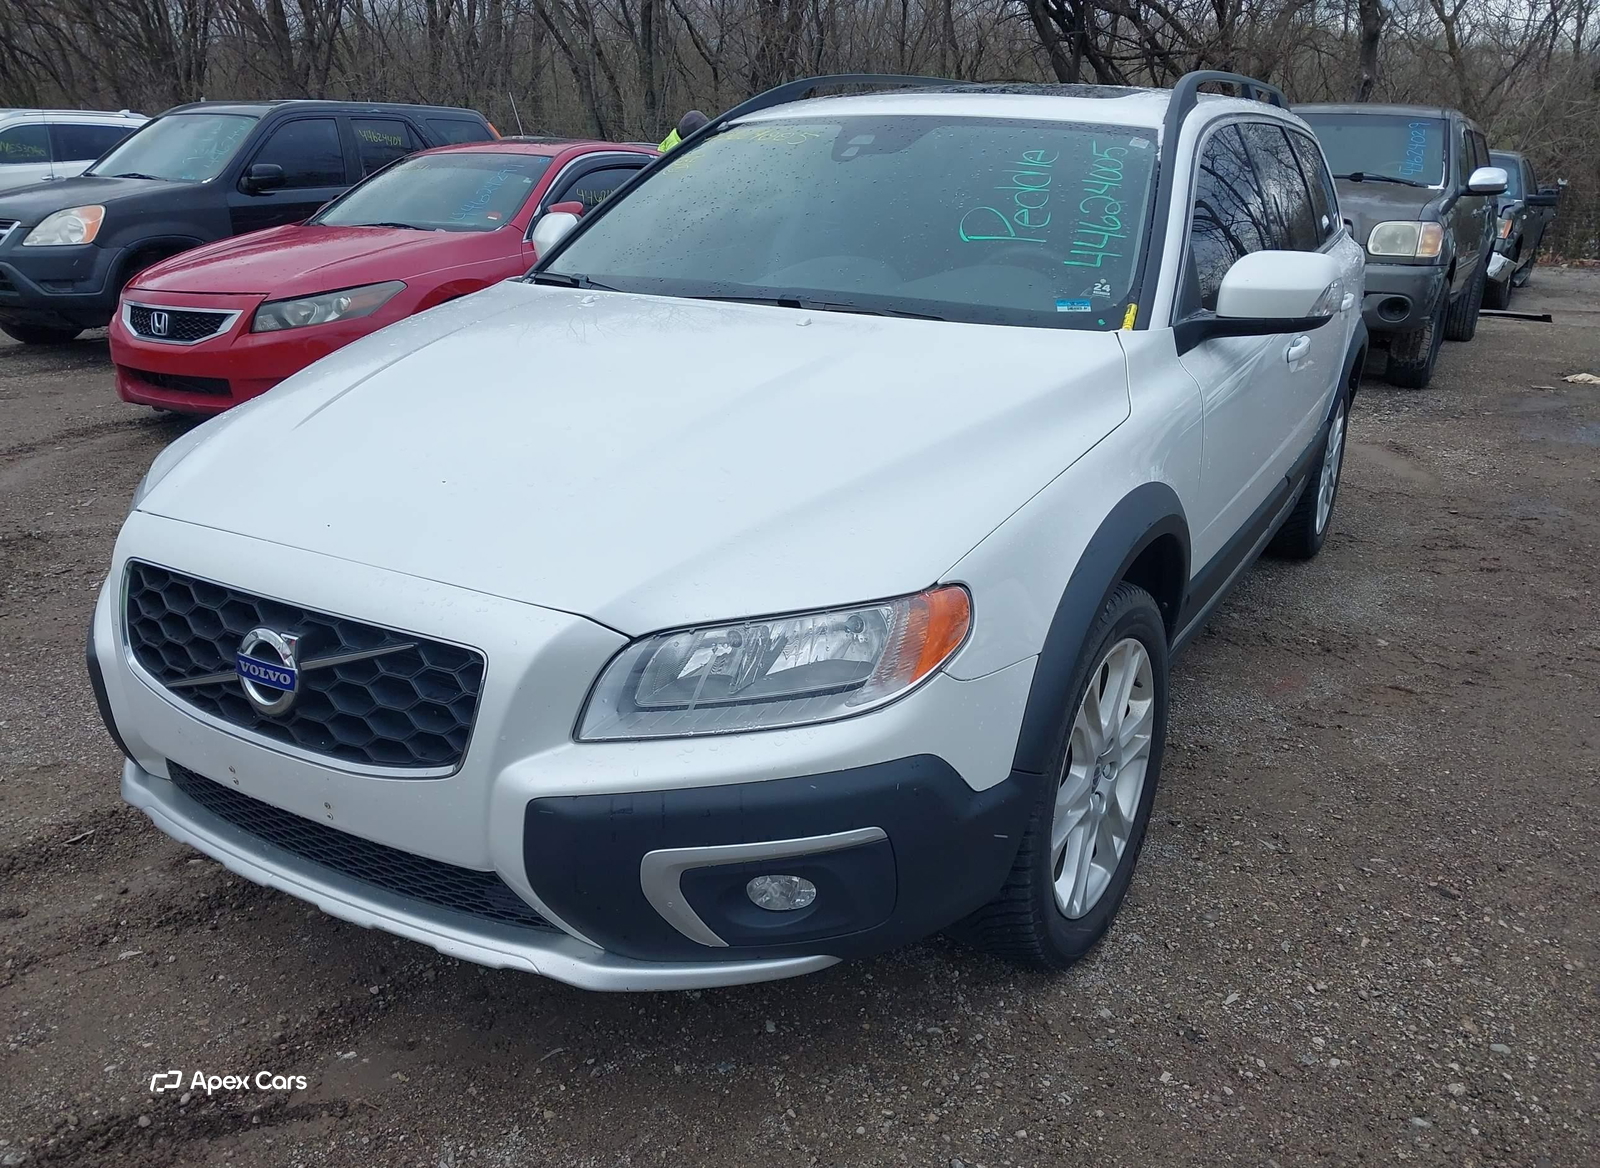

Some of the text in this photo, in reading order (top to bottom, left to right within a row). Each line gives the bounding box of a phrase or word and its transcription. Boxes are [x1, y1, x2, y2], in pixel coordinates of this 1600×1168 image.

[1402, 122, 1431, 175] 44624029
[1063, 140, 1129, 268] 44624005
[1093, 282, 1112, 292] 24
[238, 659, 291, 685] VOLVO
